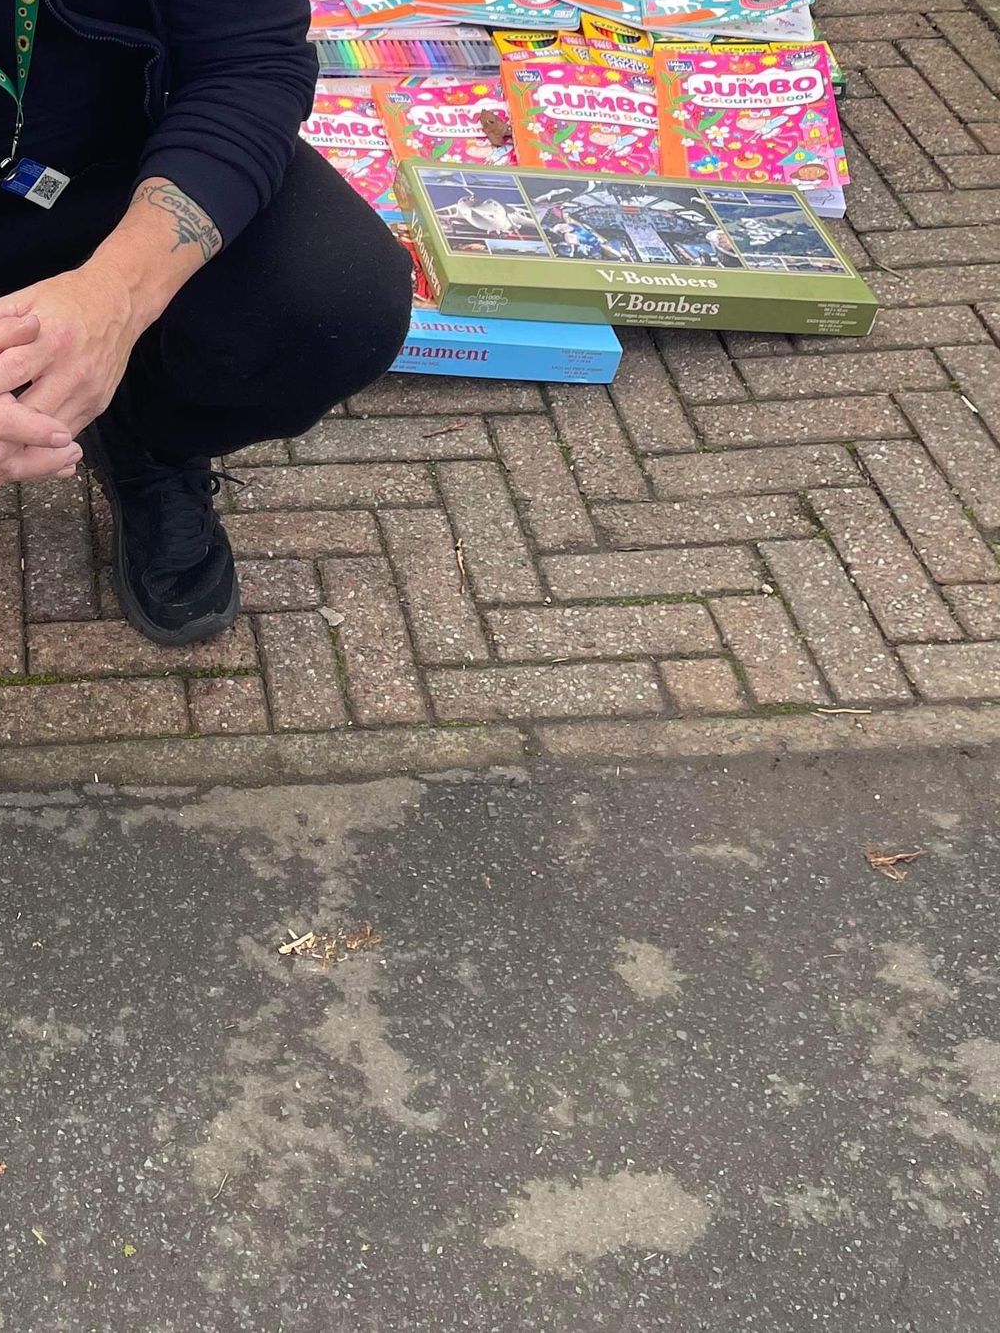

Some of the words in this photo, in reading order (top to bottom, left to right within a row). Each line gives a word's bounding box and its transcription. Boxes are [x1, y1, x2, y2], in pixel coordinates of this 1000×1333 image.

[594, 19, 639, 36] Crayola
[694, 76, 817, 97] JUMBO
[544, 92, 656, 116] JUMBO
[700, 95, 772, 105] Colouring
[776, 92, 813, 104] Book
[454, 107, 471, 116] My
[552, 107, 620, 121] Colouring
[624, 114, 658, 126] Book
[302, 121, 386, 137] UMBO
[427, 126, 484, 135] Colourin
[304, 135, 357, 145] olouring
[411, 210, 442, 297] V-Bombers
[597, 268, 718, 289] V-Bombers
[605, 292, 720, 315] V-Bombers
[411, 321, 487, 335] nament
[399, 344, 489, 362] rnament
